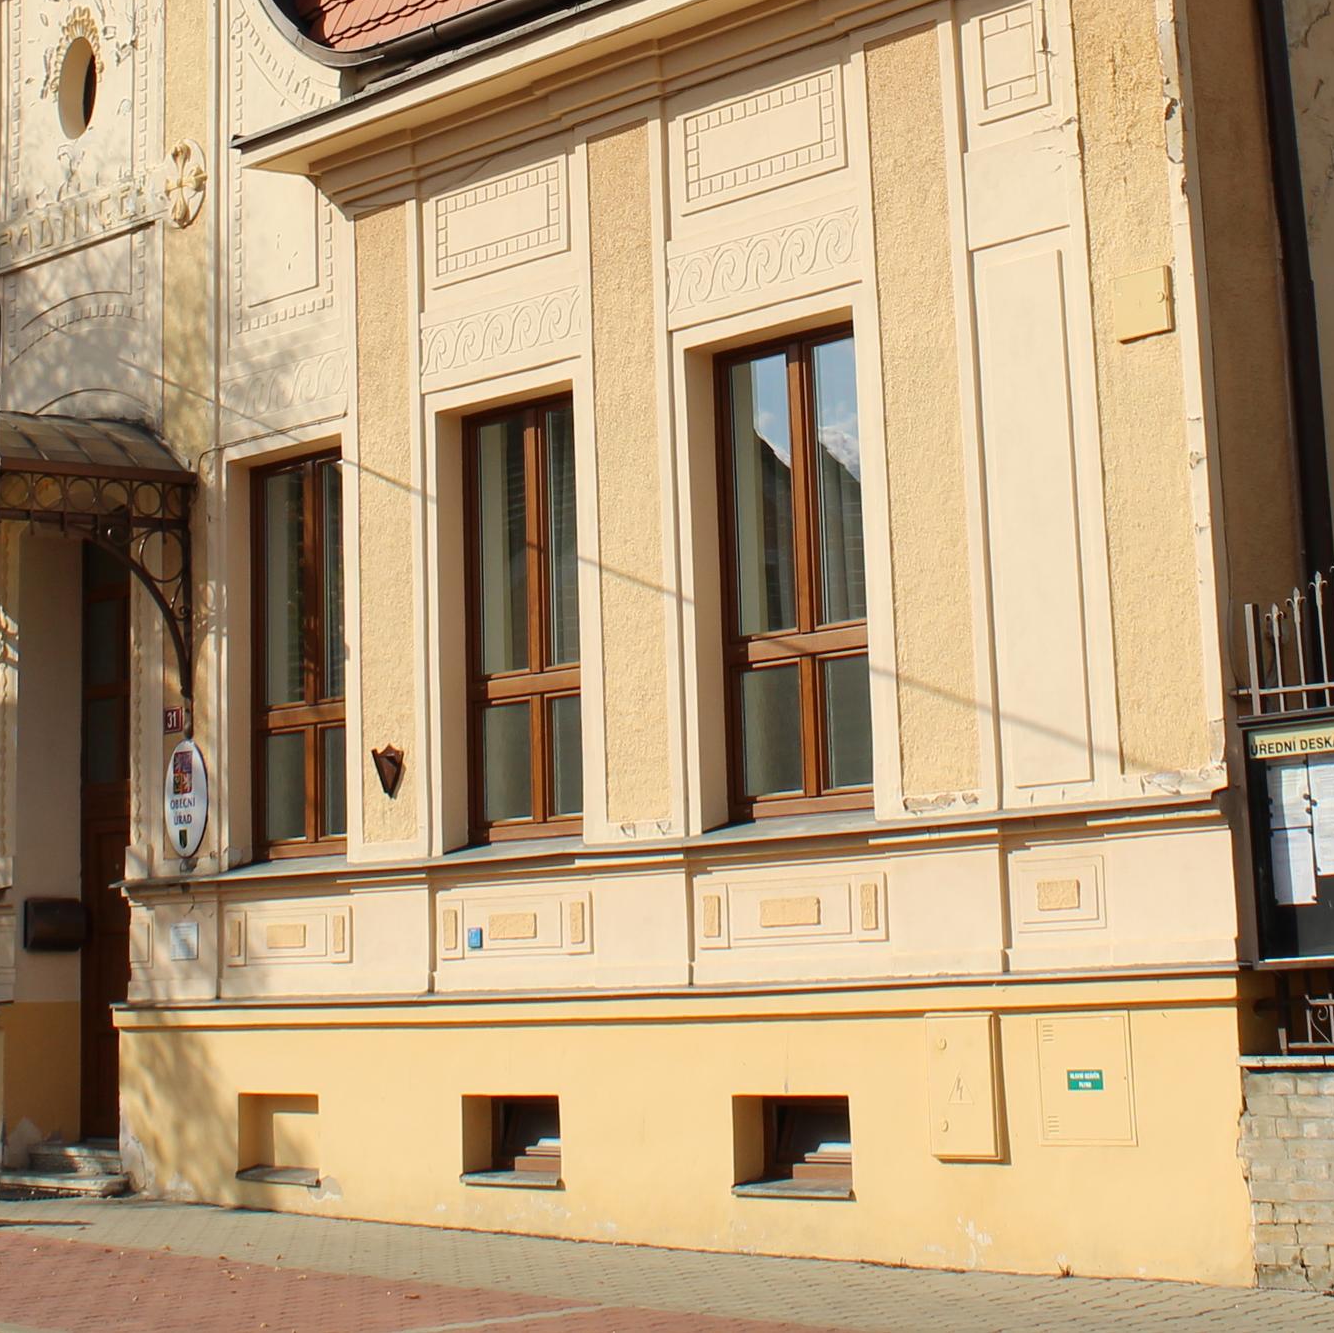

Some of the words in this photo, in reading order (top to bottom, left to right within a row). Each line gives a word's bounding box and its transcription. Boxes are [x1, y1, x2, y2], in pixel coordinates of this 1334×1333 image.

[167, 710, 177, 729] 31
[1250, 736, 1298, 757] ÚŘEDNÍ
[170, 796, 196, 810] OBECNÍ
